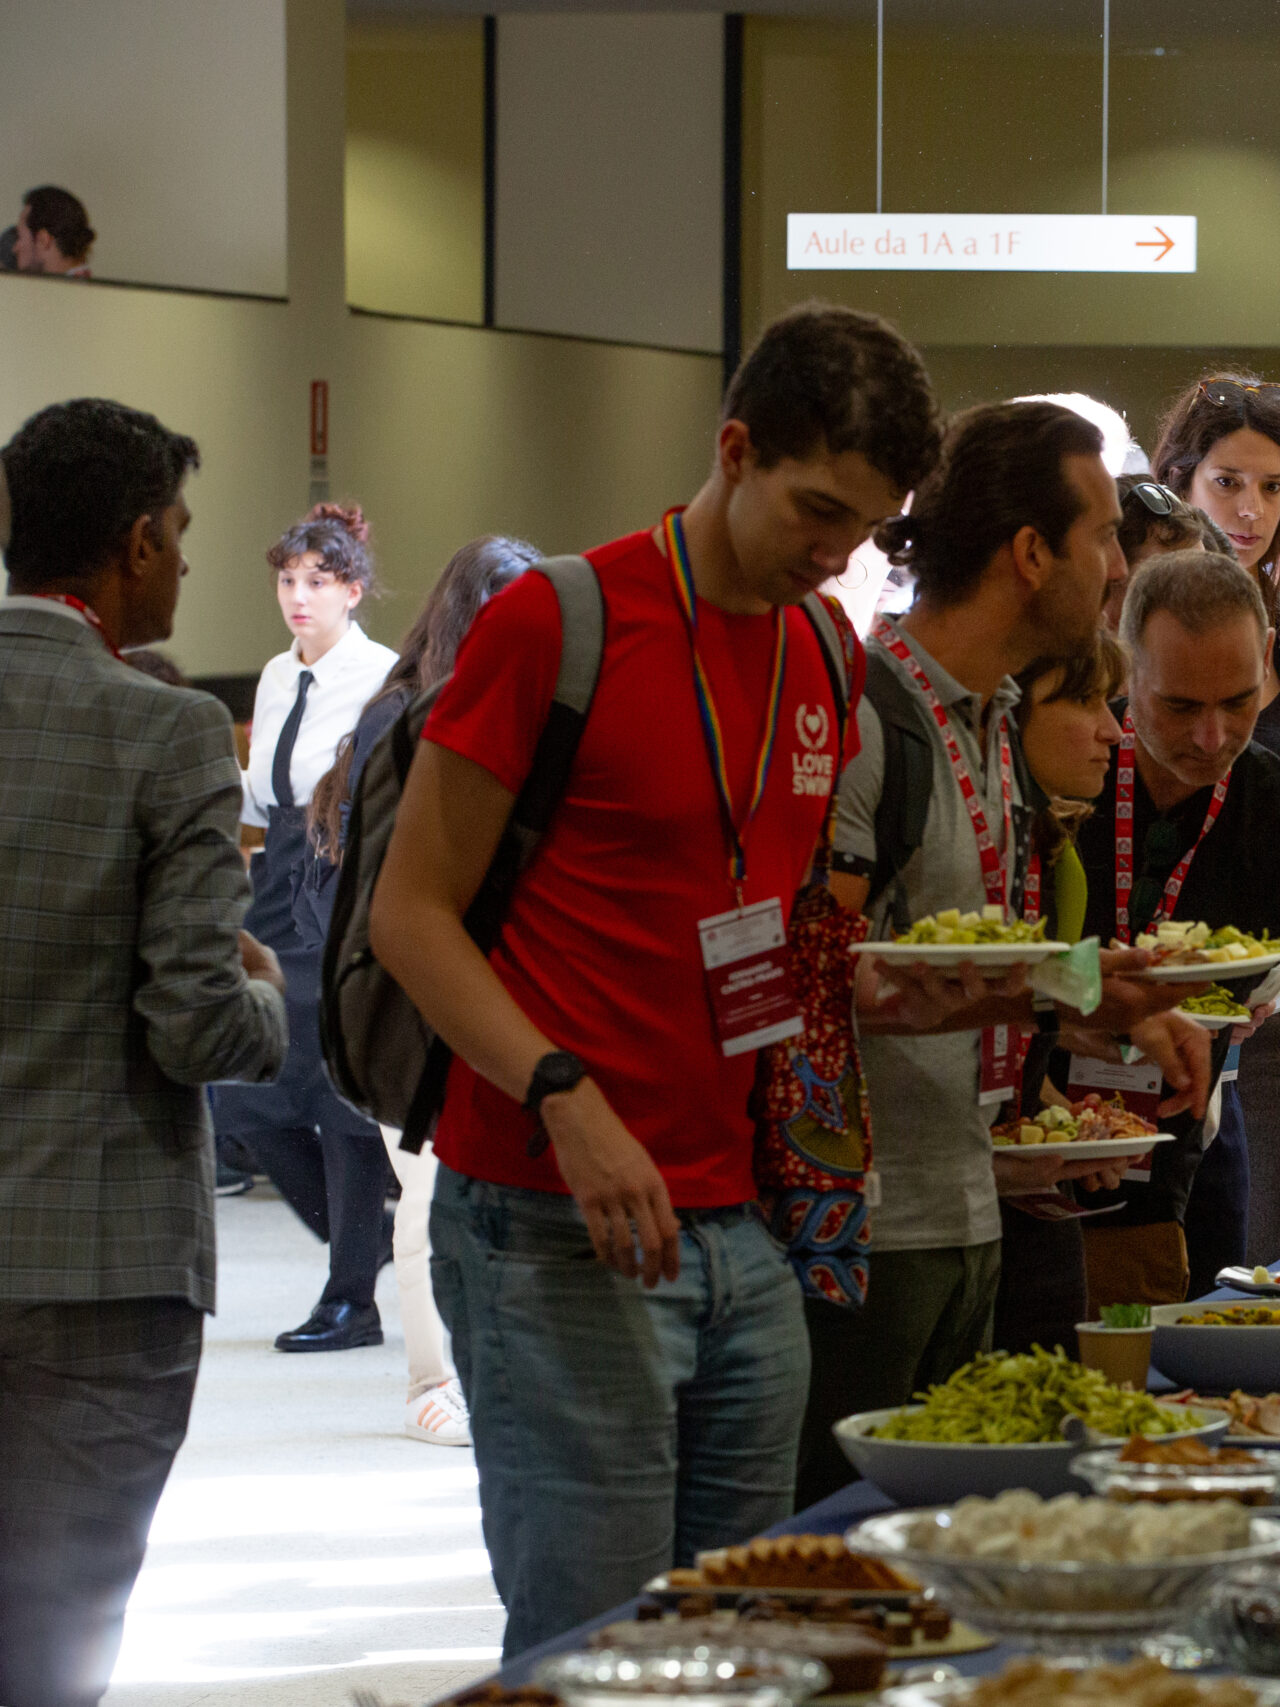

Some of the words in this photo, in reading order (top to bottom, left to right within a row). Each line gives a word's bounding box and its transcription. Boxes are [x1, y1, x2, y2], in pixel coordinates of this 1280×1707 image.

[804, 228, 865, 255] Aule
[874, 228, 906, 255] da
[918, 231, 954, 256] 1A
[963, 237, 978, 256] a
[990, 231, 1021, 256] 1F
[791, 751, 834, 776] LOVE
